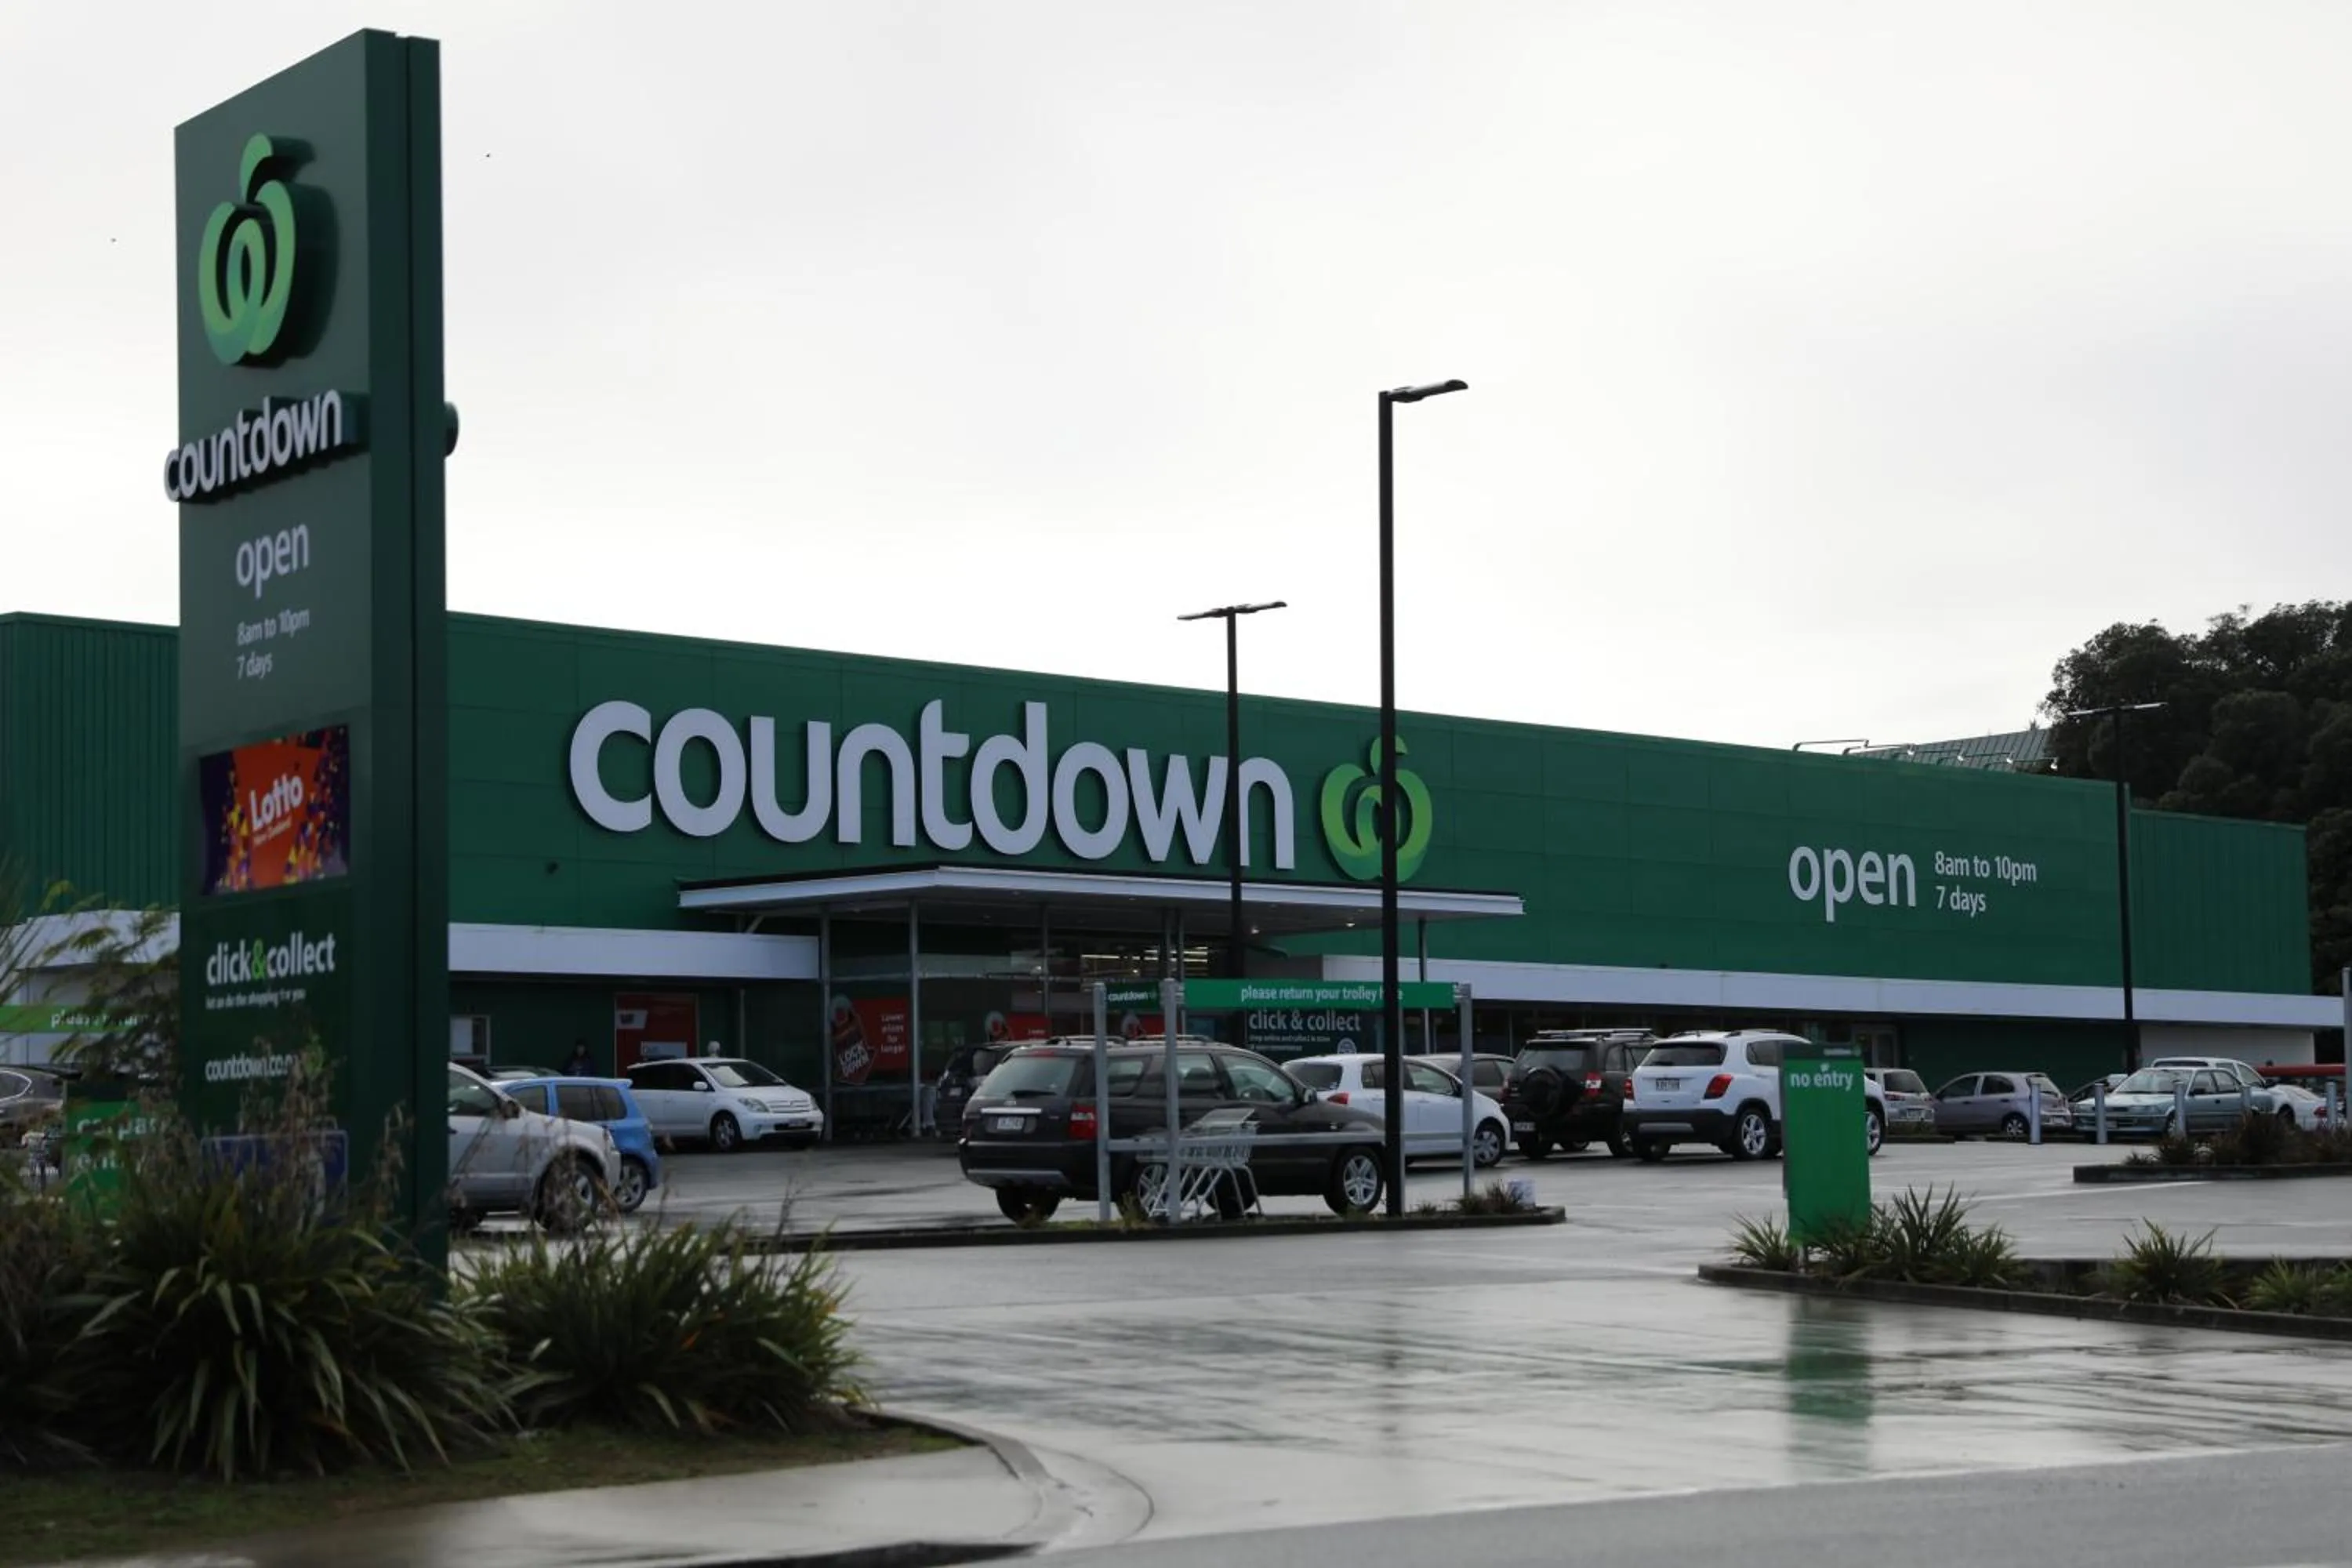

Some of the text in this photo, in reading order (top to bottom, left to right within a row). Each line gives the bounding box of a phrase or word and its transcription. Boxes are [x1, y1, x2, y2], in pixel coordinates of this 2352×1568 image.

[164, 390, 343, 502] countdown
[236, 523, 309, 598] open
[238, 608, 310, 647] 8am to 10pm
[237, 650, 272, 680] 7 days
[249, 771, 304, 830] Lotto
[570, 699, 1294, 869] countdown
[1788, 846, 1917, 923] open
[1934, 851, 2038, 886] 8am to 10pm
[1936, 885, 1987, 917] 7 days
[206, 931, 336, 986] click&collect
[1108, 990, 1149, 1001] countdown
[1241, 985, 1277, 1002] please
[1279, 988, 1313, 1000] return
[1316, 989, 1340, 1002] your
[1342, 985, 1377, 1003] trolley
[1248, 1009, 1362, 1032] click & collect
[1789, 1070, 1853, 1092] no entry
